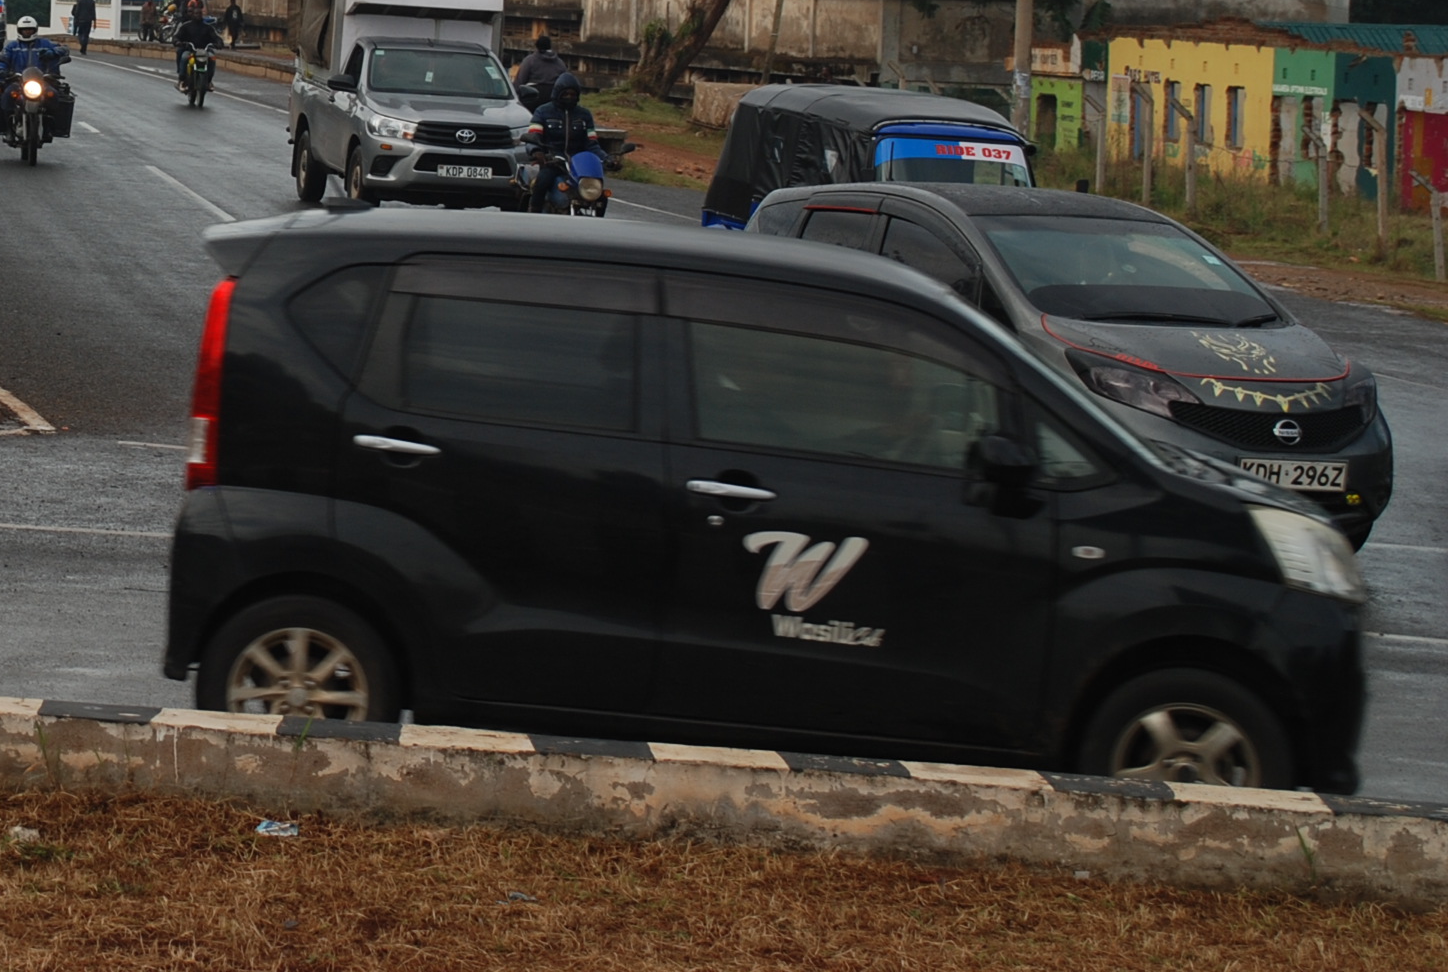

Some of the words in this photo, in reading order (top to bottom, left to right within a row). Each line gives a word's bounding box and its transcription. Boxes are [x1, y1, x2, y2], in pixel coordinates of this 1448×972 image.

[935, 144, 976, 157] RIDE
[981, 147, 1012, 160] 037
[445, 166, 463, 177] KDP
[467, 167, 489, 178] 084R
[1243, 461, 1282, 485] KDH
[1290, 464, 1344, 488] 296Z
